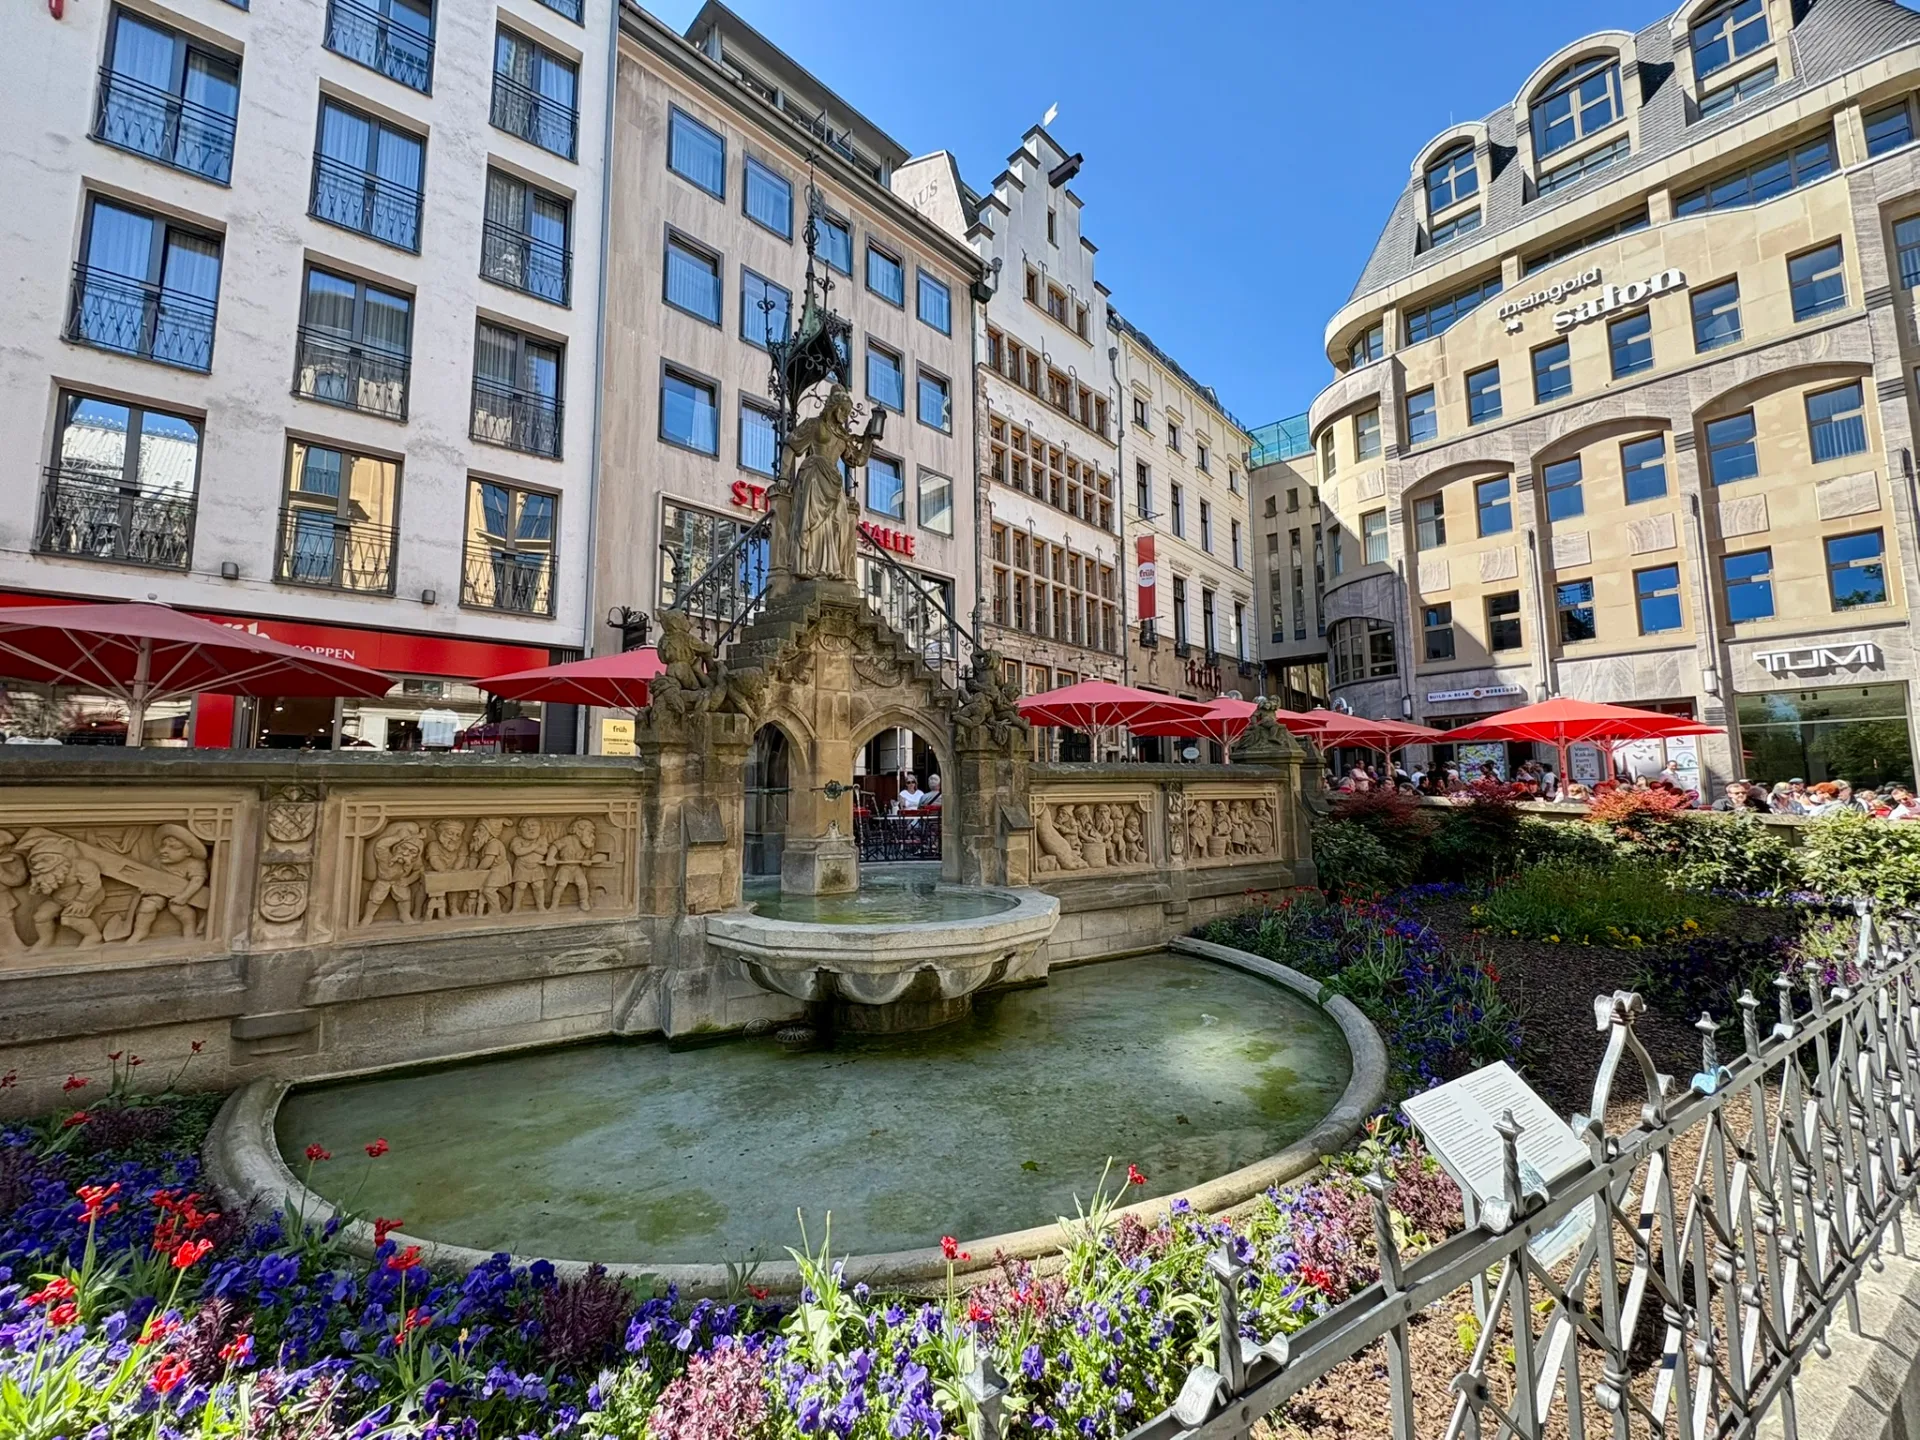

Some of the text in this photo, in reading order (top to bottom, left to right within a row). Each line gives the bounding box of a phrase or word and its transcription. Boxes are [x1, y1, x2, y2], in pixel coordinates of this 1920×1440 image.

[1497, 266, 1601, 319] rheingold
[1552, 267, 1684, 330] salon
[1752, 640, 1876, 673] TUMI
